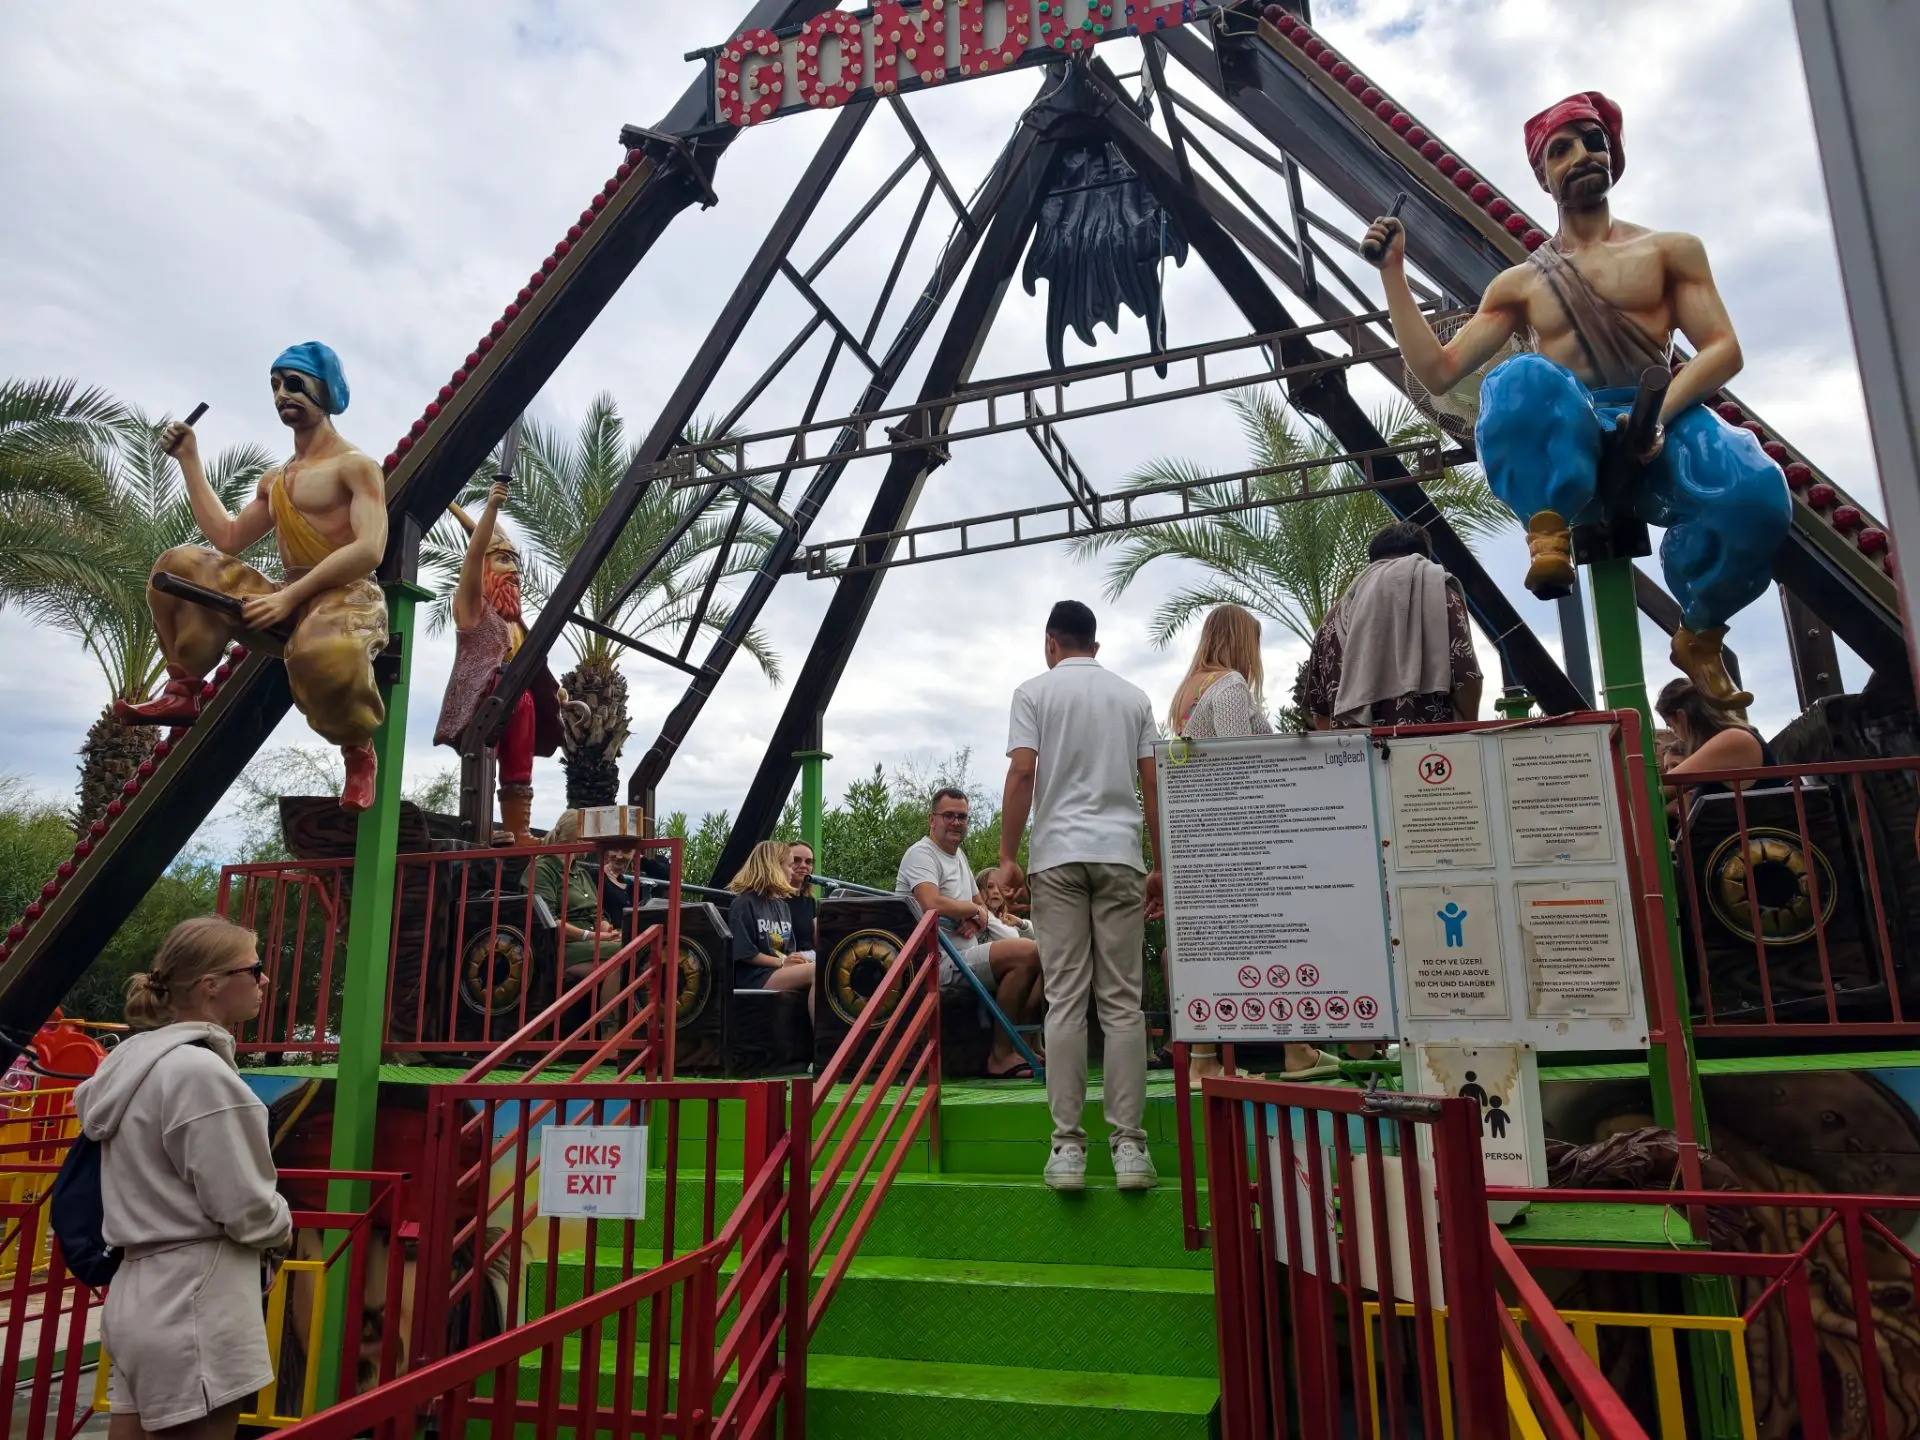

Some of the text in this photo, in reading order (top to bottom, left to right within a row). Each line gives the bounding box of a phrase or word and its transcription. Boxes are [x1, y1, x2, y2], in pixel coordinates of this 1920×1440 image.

[1325, 750, 1366, 767] LongBeach
[1425, 762, 1446, 776] 18
[564, 1144, 622, 1168] ÇIKIŞ
[1485, 1152, 1522, 1160] PERSON
[566, 1174, 617, 1195] EXIT
